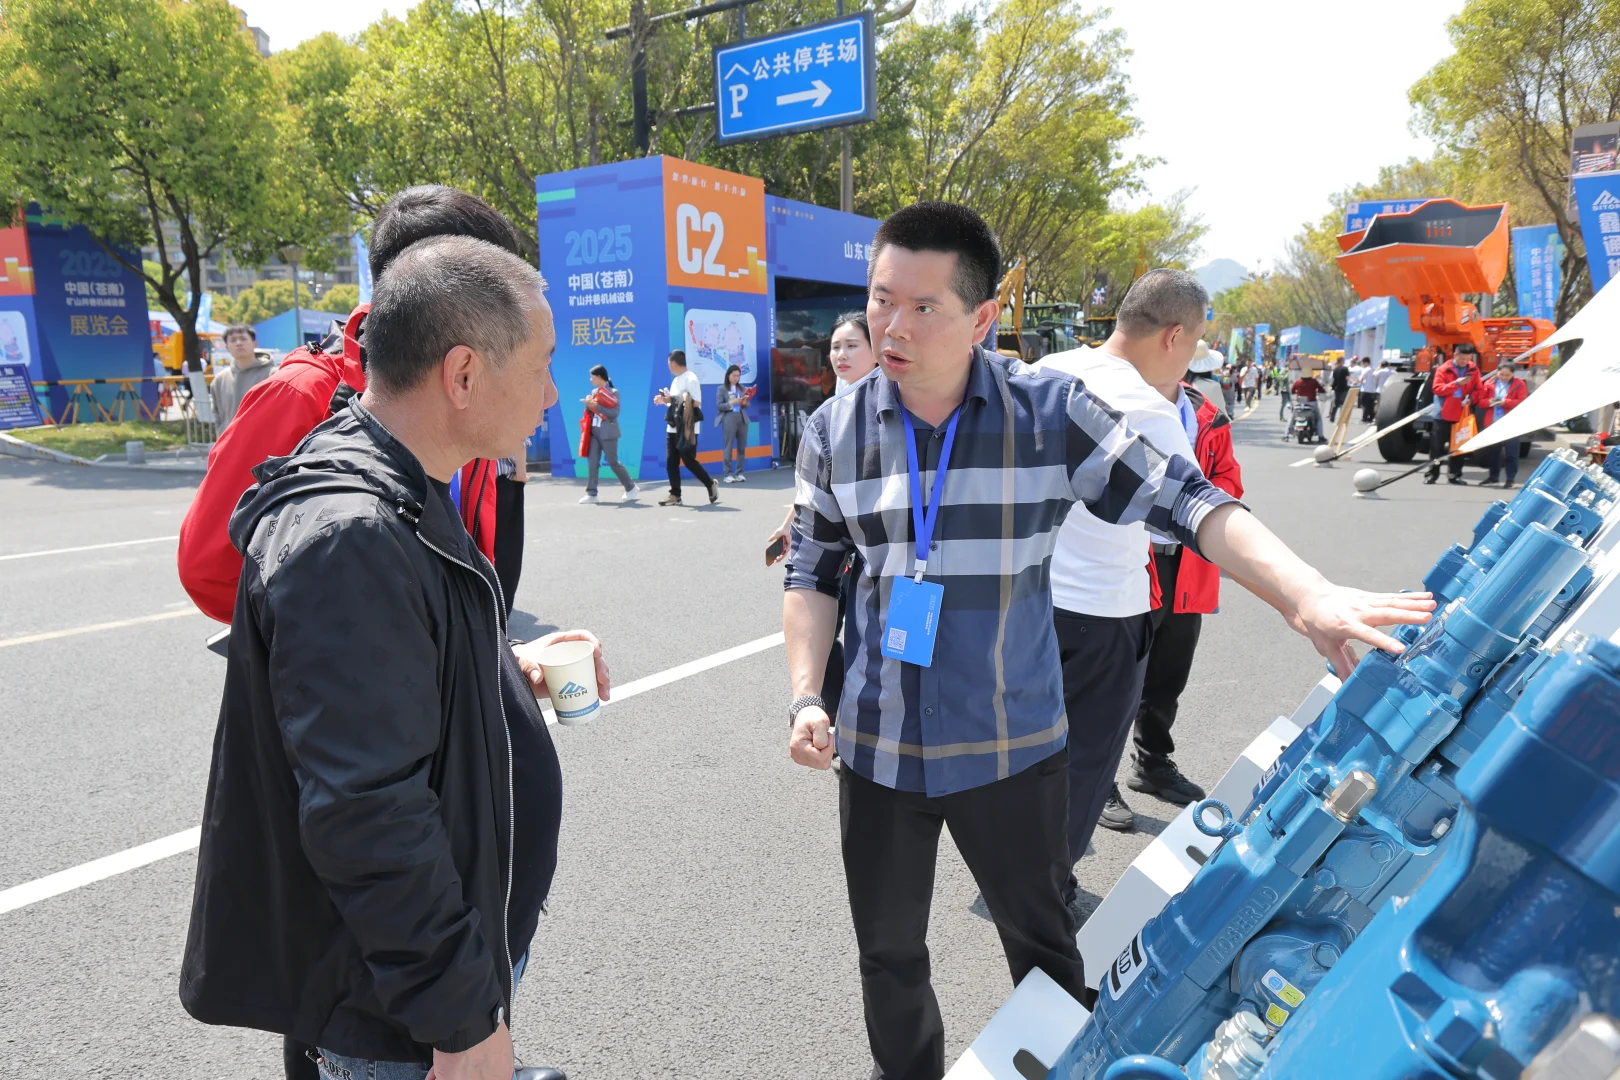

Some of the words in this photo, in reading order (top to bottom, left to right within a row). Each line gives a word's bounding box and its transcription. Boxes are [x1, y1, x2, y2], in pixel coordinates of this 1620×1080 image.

[752, 37, 858, 81] 公共停车场
[729, 83, 748, 119] P
[565, 224, 632, 266] 2025
[676, 203, 725, 276] C2
[70, 314, 129, 336] 展览会
[571, 315, 636, 346] 展览会
[558, 690, 588, 700] SITON
